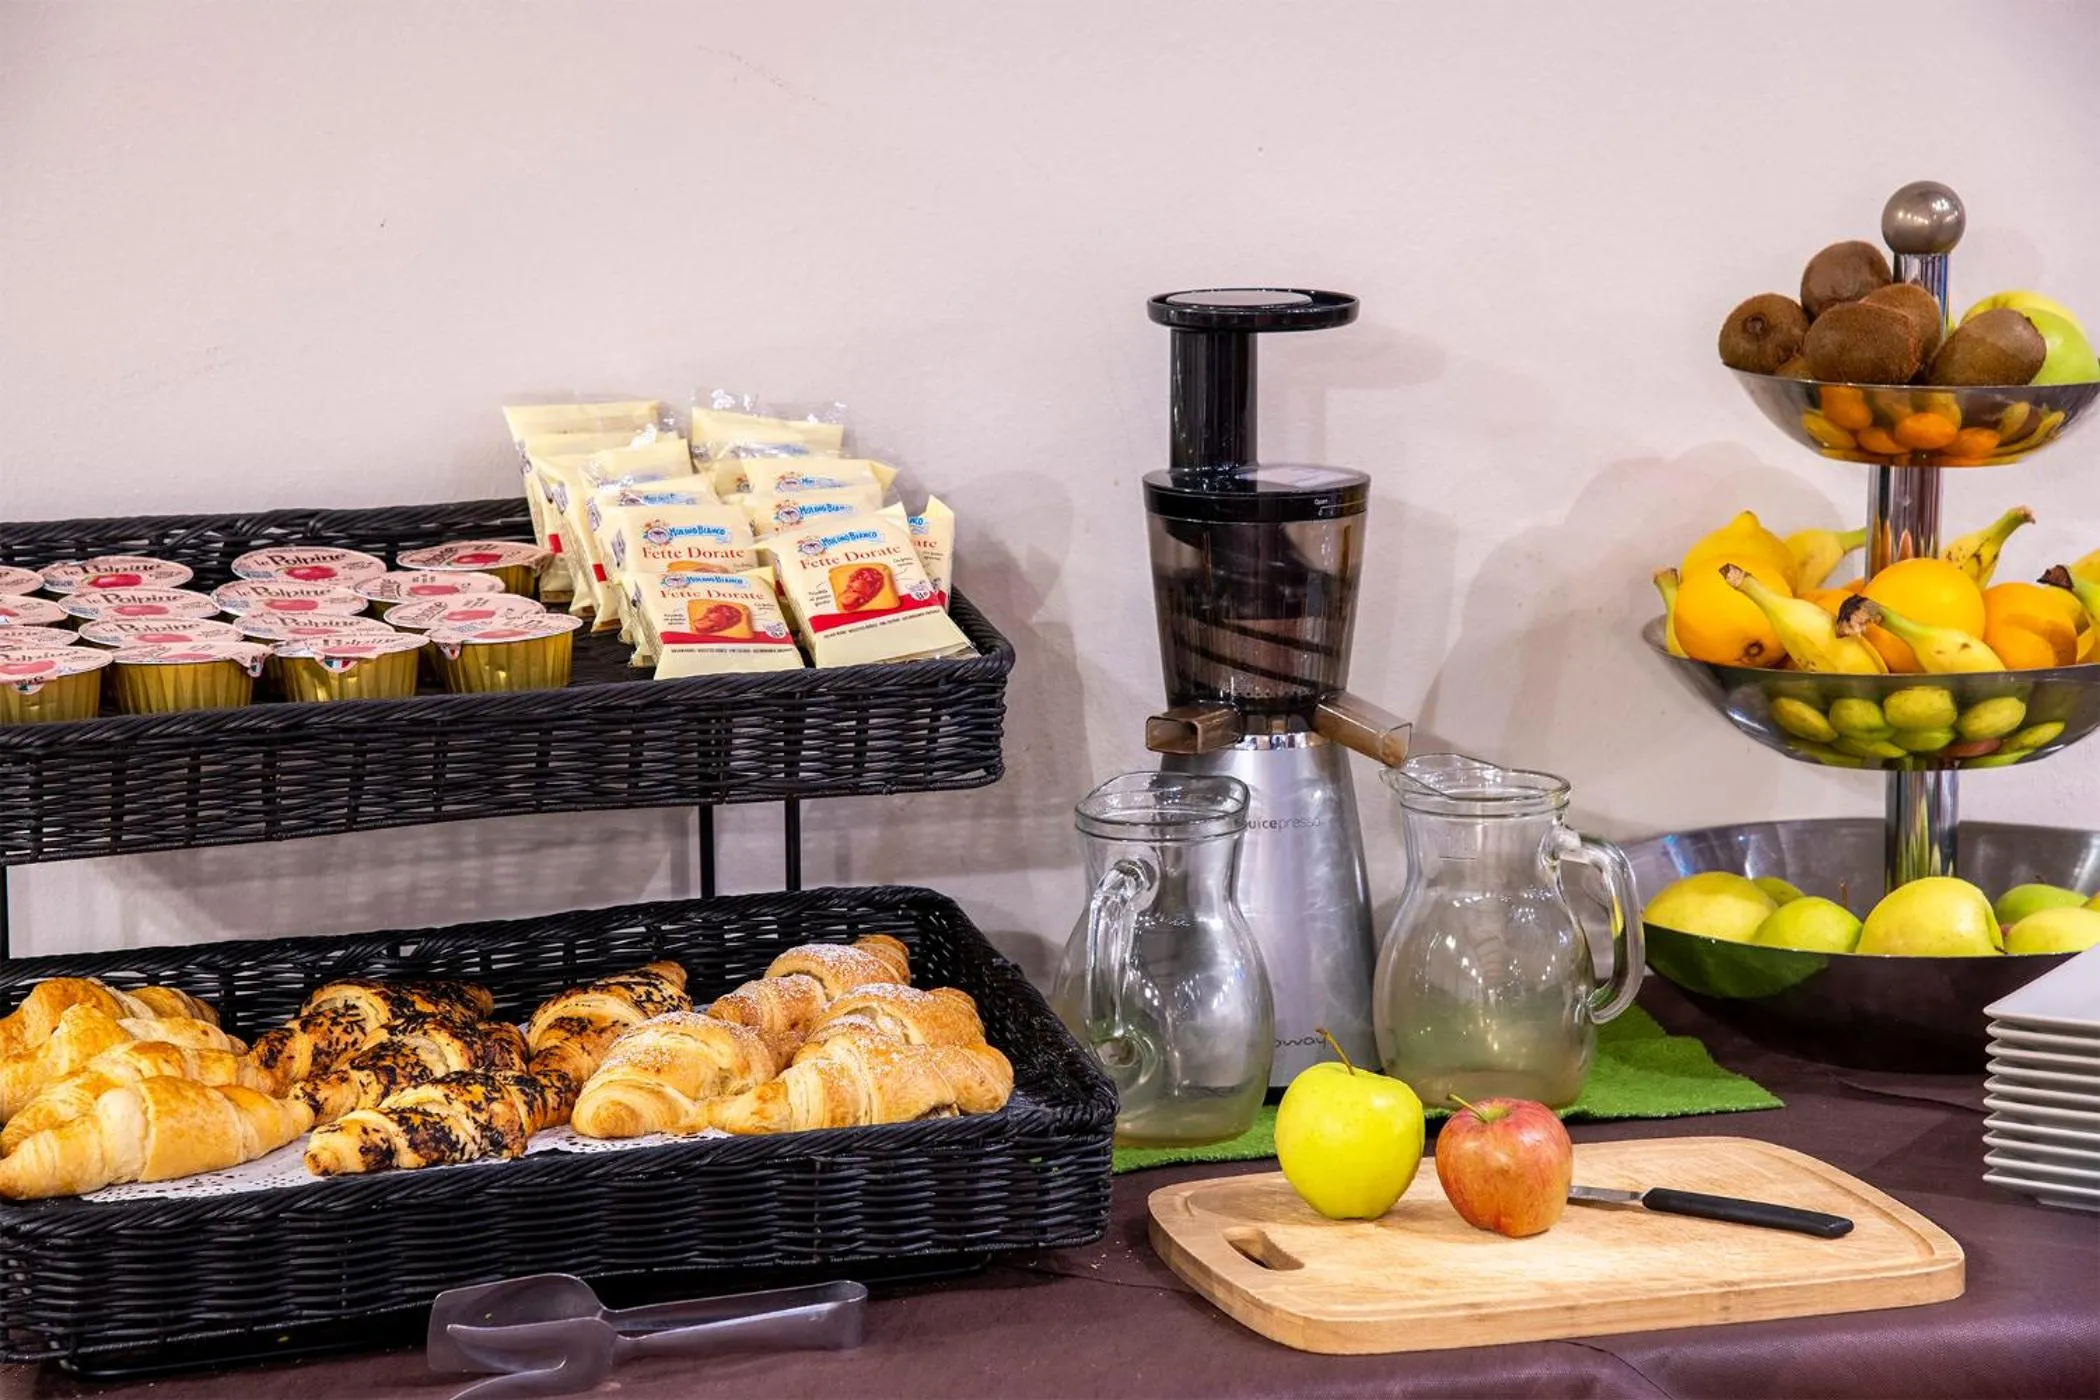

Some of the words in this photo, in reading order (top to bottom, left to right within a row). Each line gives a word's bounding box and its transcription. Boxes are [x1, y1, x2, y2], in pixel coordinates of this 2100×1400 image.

[641, 547, 683, 559] Fette
[687, 546, 745, 559] Dorate
[800, 556, 840, 570] Fette
[844, 545, 901, 561] Dorate
[267, 553, 347, 567] Polpine
[250, 586, 332, 598] Polpine
[706, 590, 765, 600] Dorate
[100, 593, 184, 604] Polpine
[115, 623, 201, 634] Polpine
[278, 617, 361, 628] Polpine
[1246, 817, 1321, 832] uicepresso
